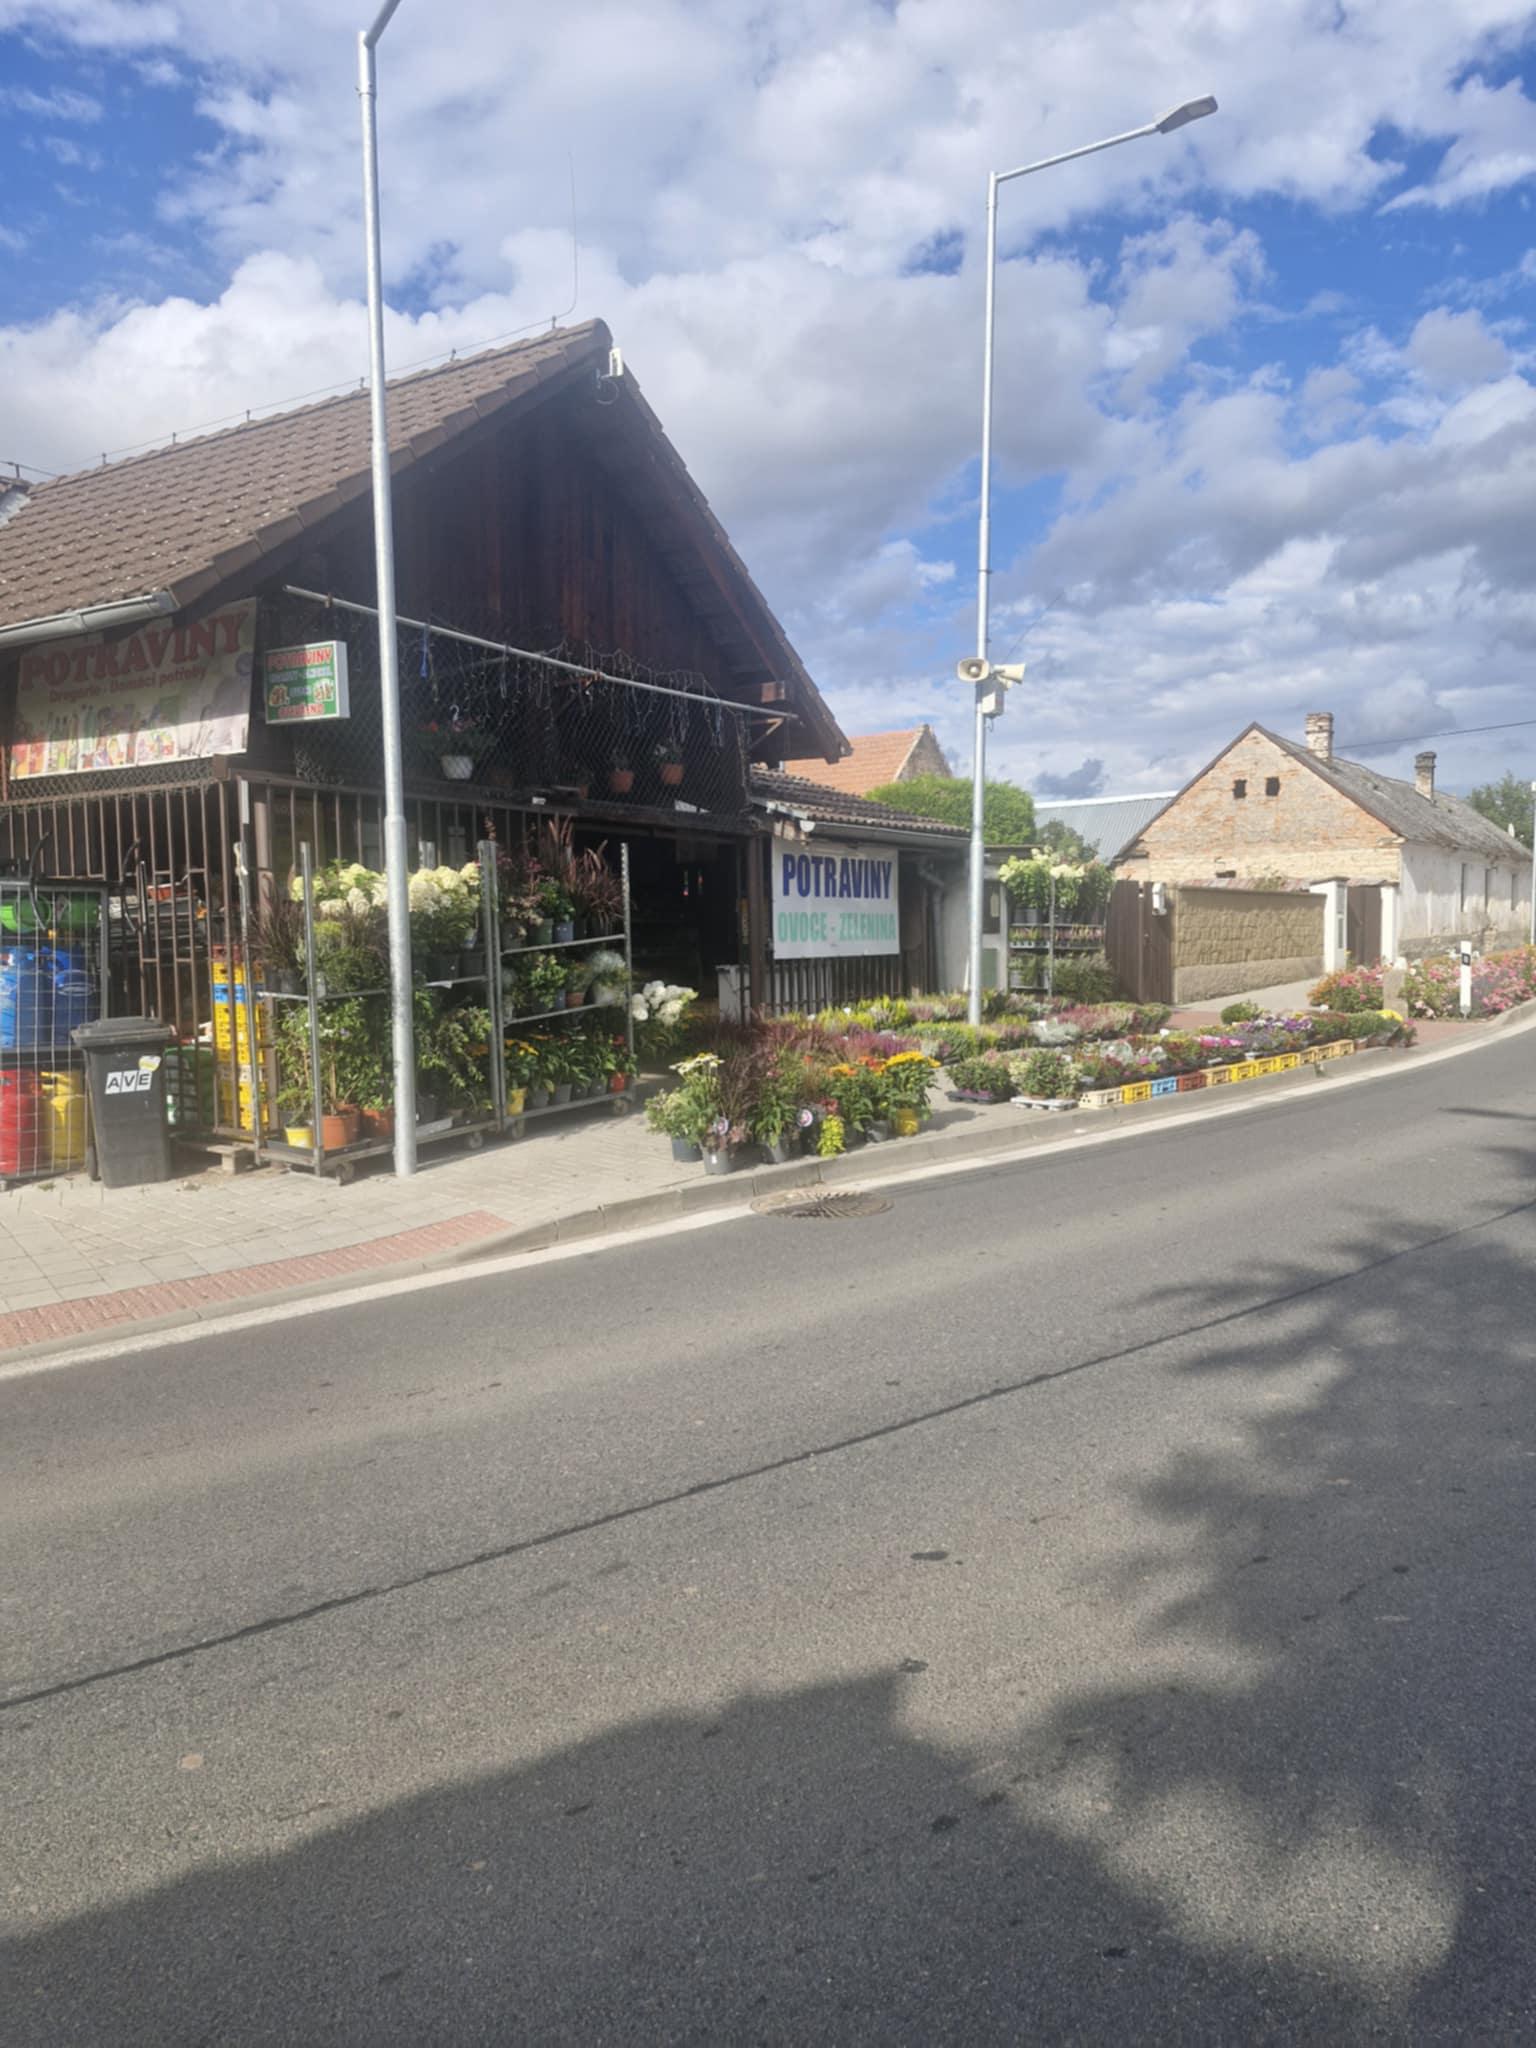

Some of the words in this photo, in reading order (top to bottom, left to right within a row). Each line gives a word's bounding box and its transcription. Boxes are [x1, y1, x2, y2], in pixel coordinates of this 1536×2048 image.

[20, 612, 248, 690] POTRAVINY
[782, 853, 892, 899] POTRAVINY
[778, 911, 827, 942] OVOCE
[839, 913, 896, 941] ZELENINA
[107, 1073, 149, 1088] AVE
